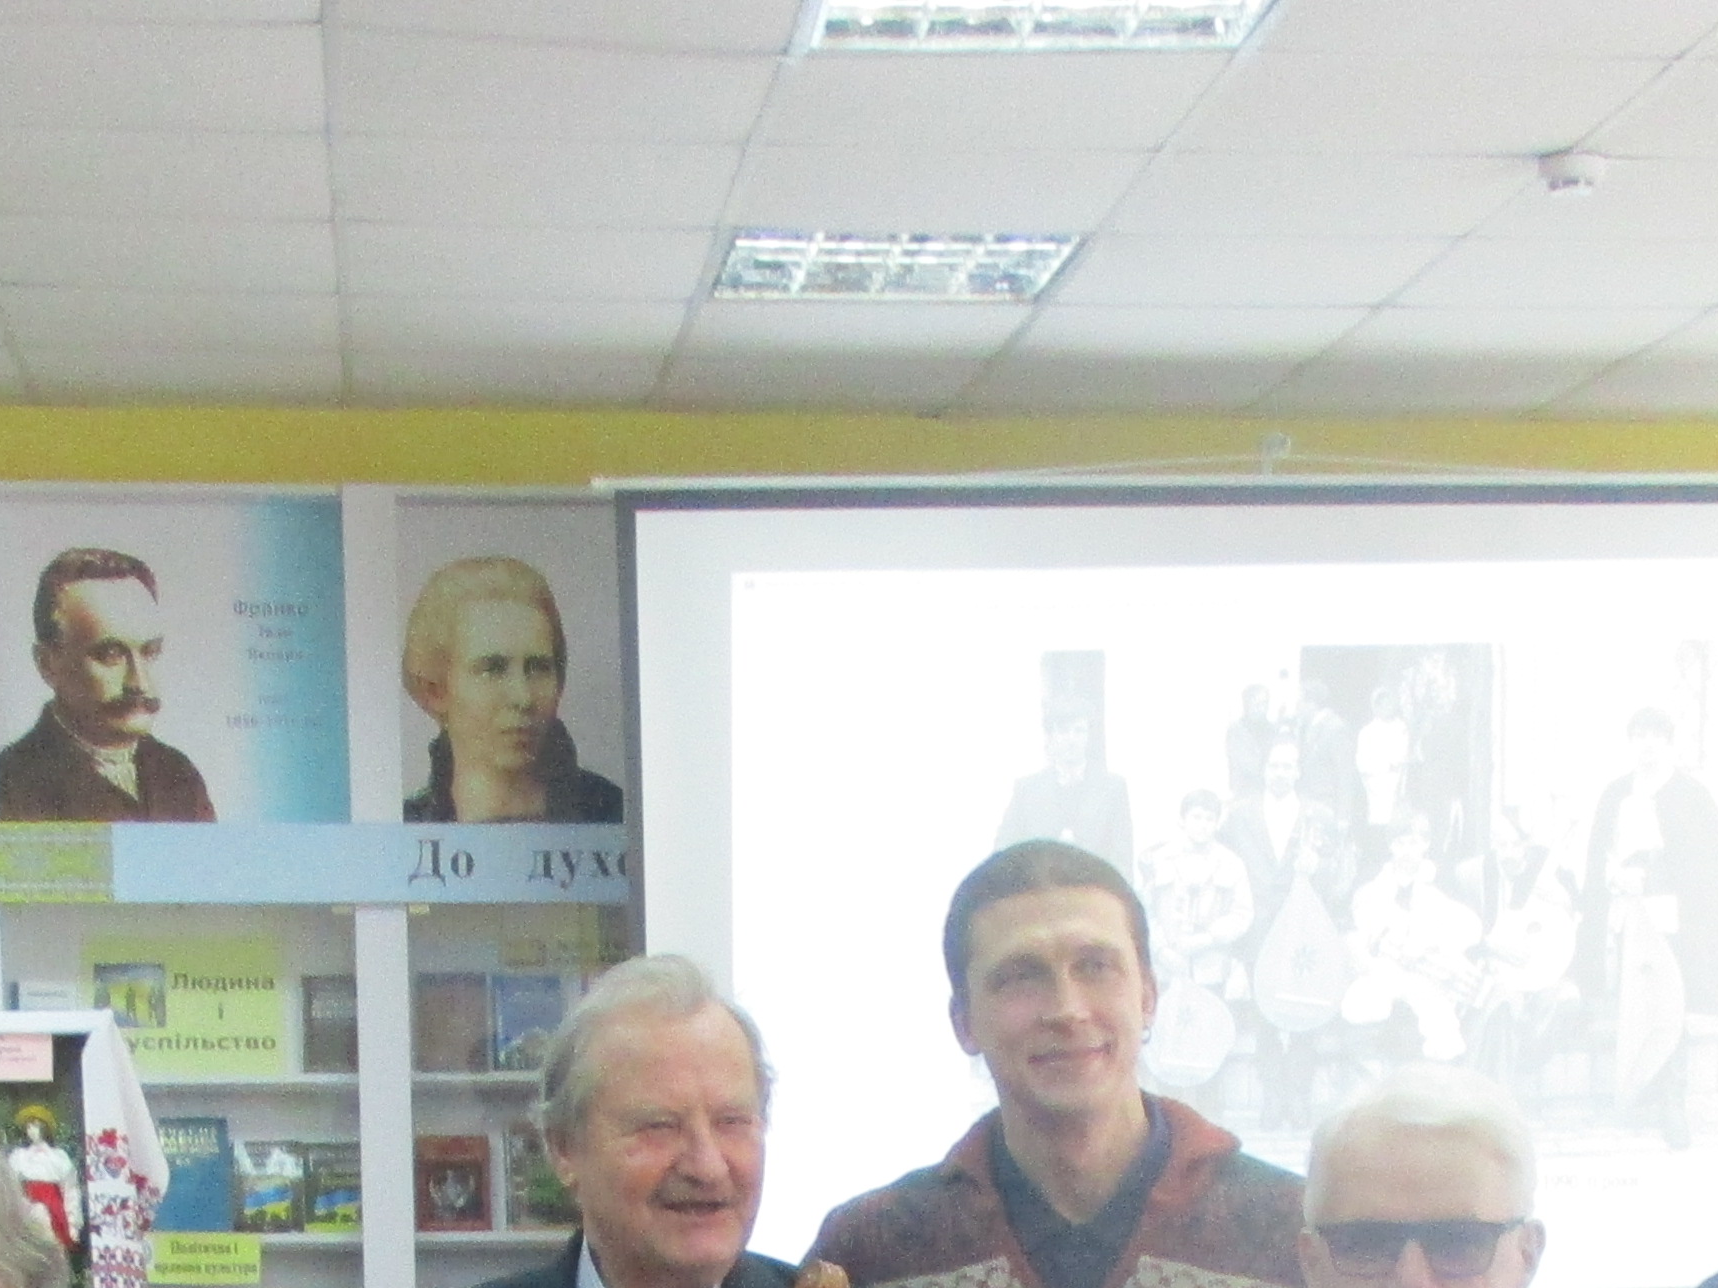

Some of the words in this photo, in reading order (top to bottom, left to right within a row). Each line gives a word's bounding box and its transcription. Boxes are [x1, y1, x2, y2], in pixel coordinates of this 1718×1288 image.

[408, 838, 475, 887] До
[172, 973, 276, 992] Людина
[127, 1033, 277, 1055] успільство
